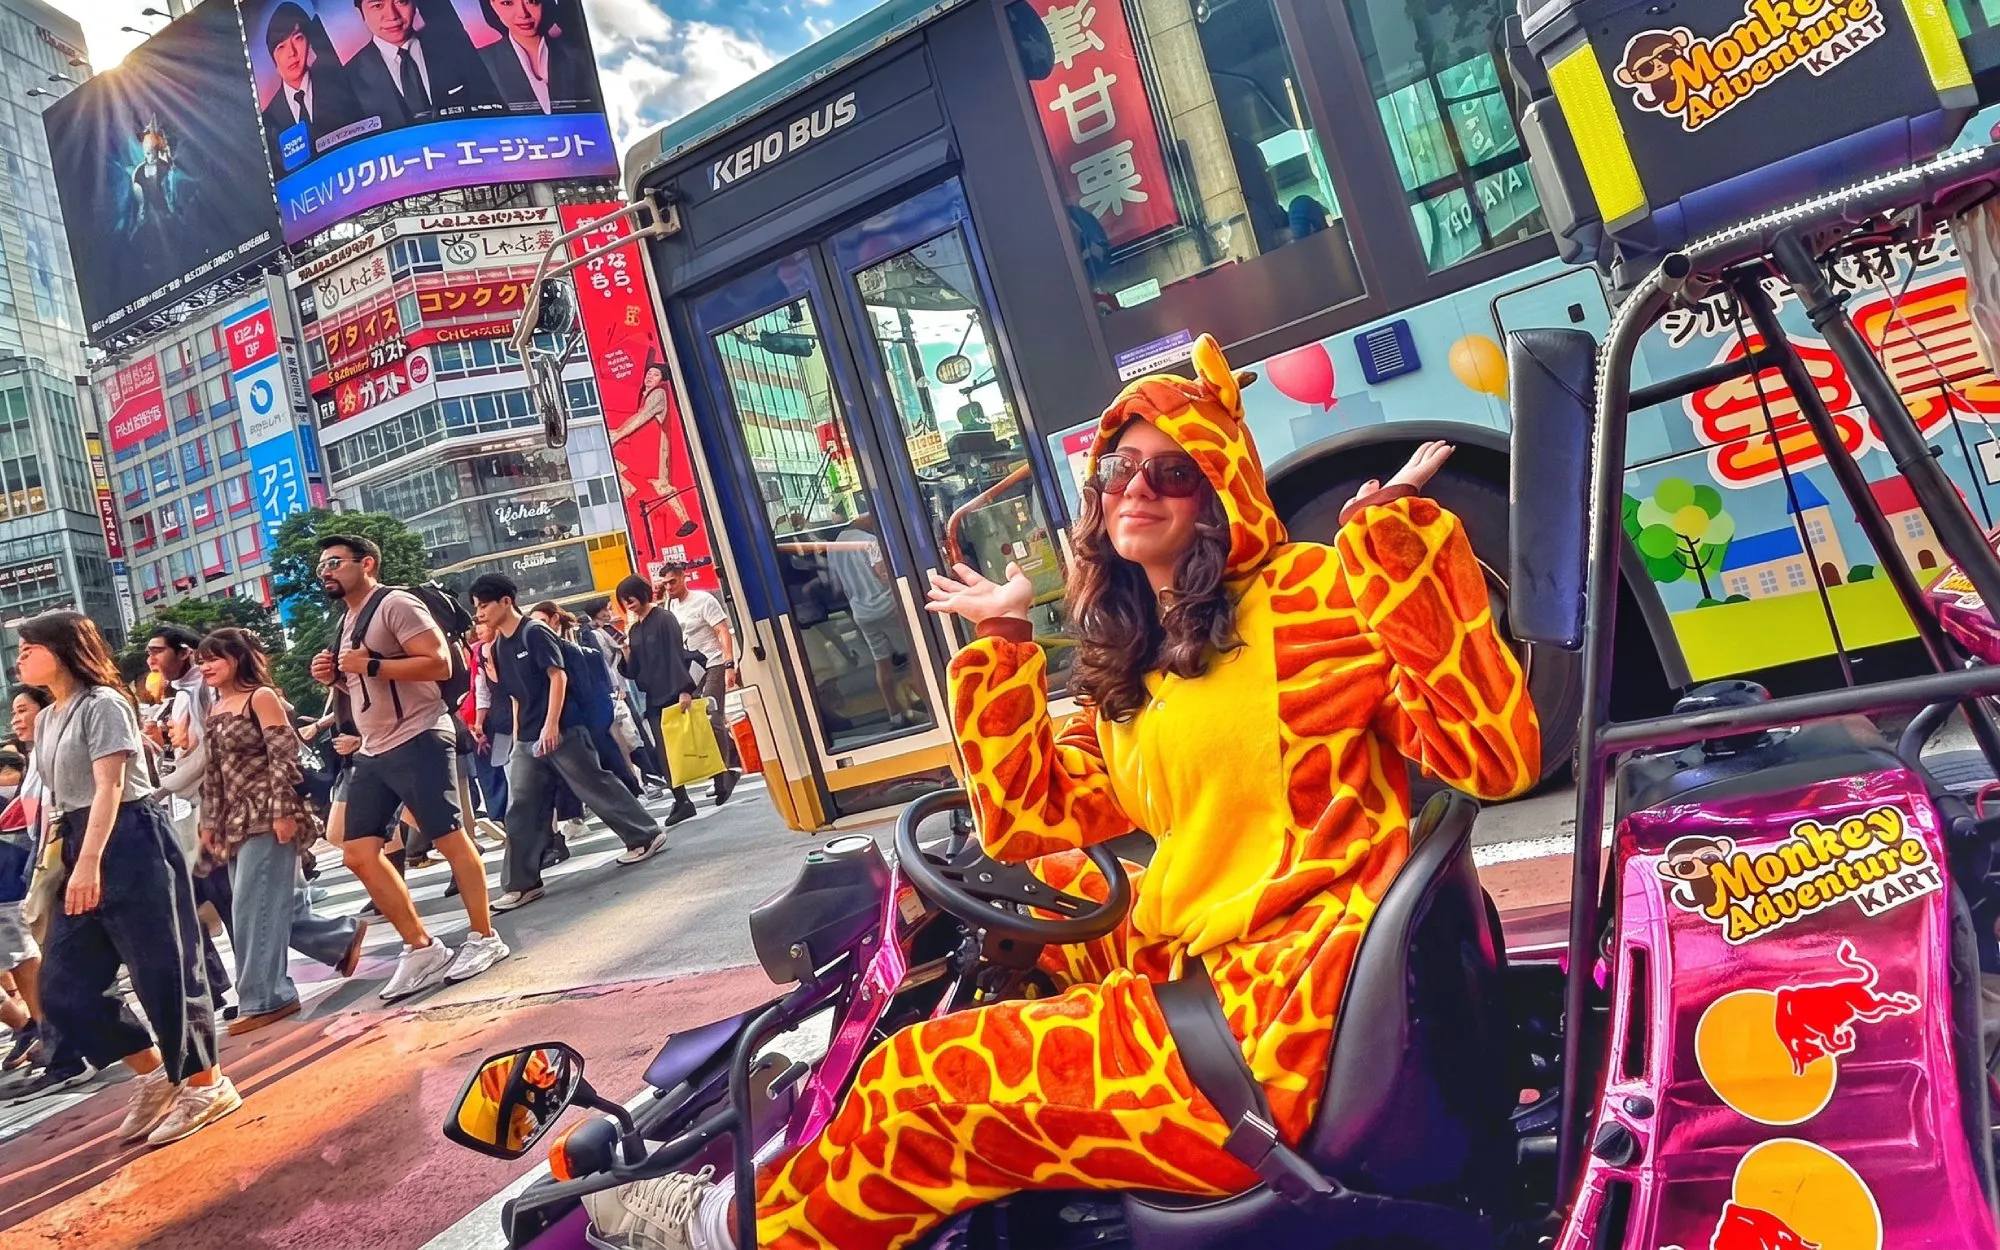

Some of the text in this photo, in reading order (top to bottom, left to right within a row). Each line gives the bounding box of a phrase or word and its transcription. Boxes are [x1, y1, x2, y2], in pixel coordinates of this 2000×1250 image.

[1664, 0, 1845, 111] Monke
[1687, 0, 1873, 127] Adventure
[1807, 15, 1882, 73] KART
[289, 175, 335, 222] NEW
[336, 145, 446, 195] リクルート
[455, 134, 596, 166] エージェント
[713, 91, 857, 191] KEIO BUS
[1705, 806, 1903, 918] Monkey
[1726, 838, 1926, 939] Adventure
[1857, 866, 1940, 913] KART
